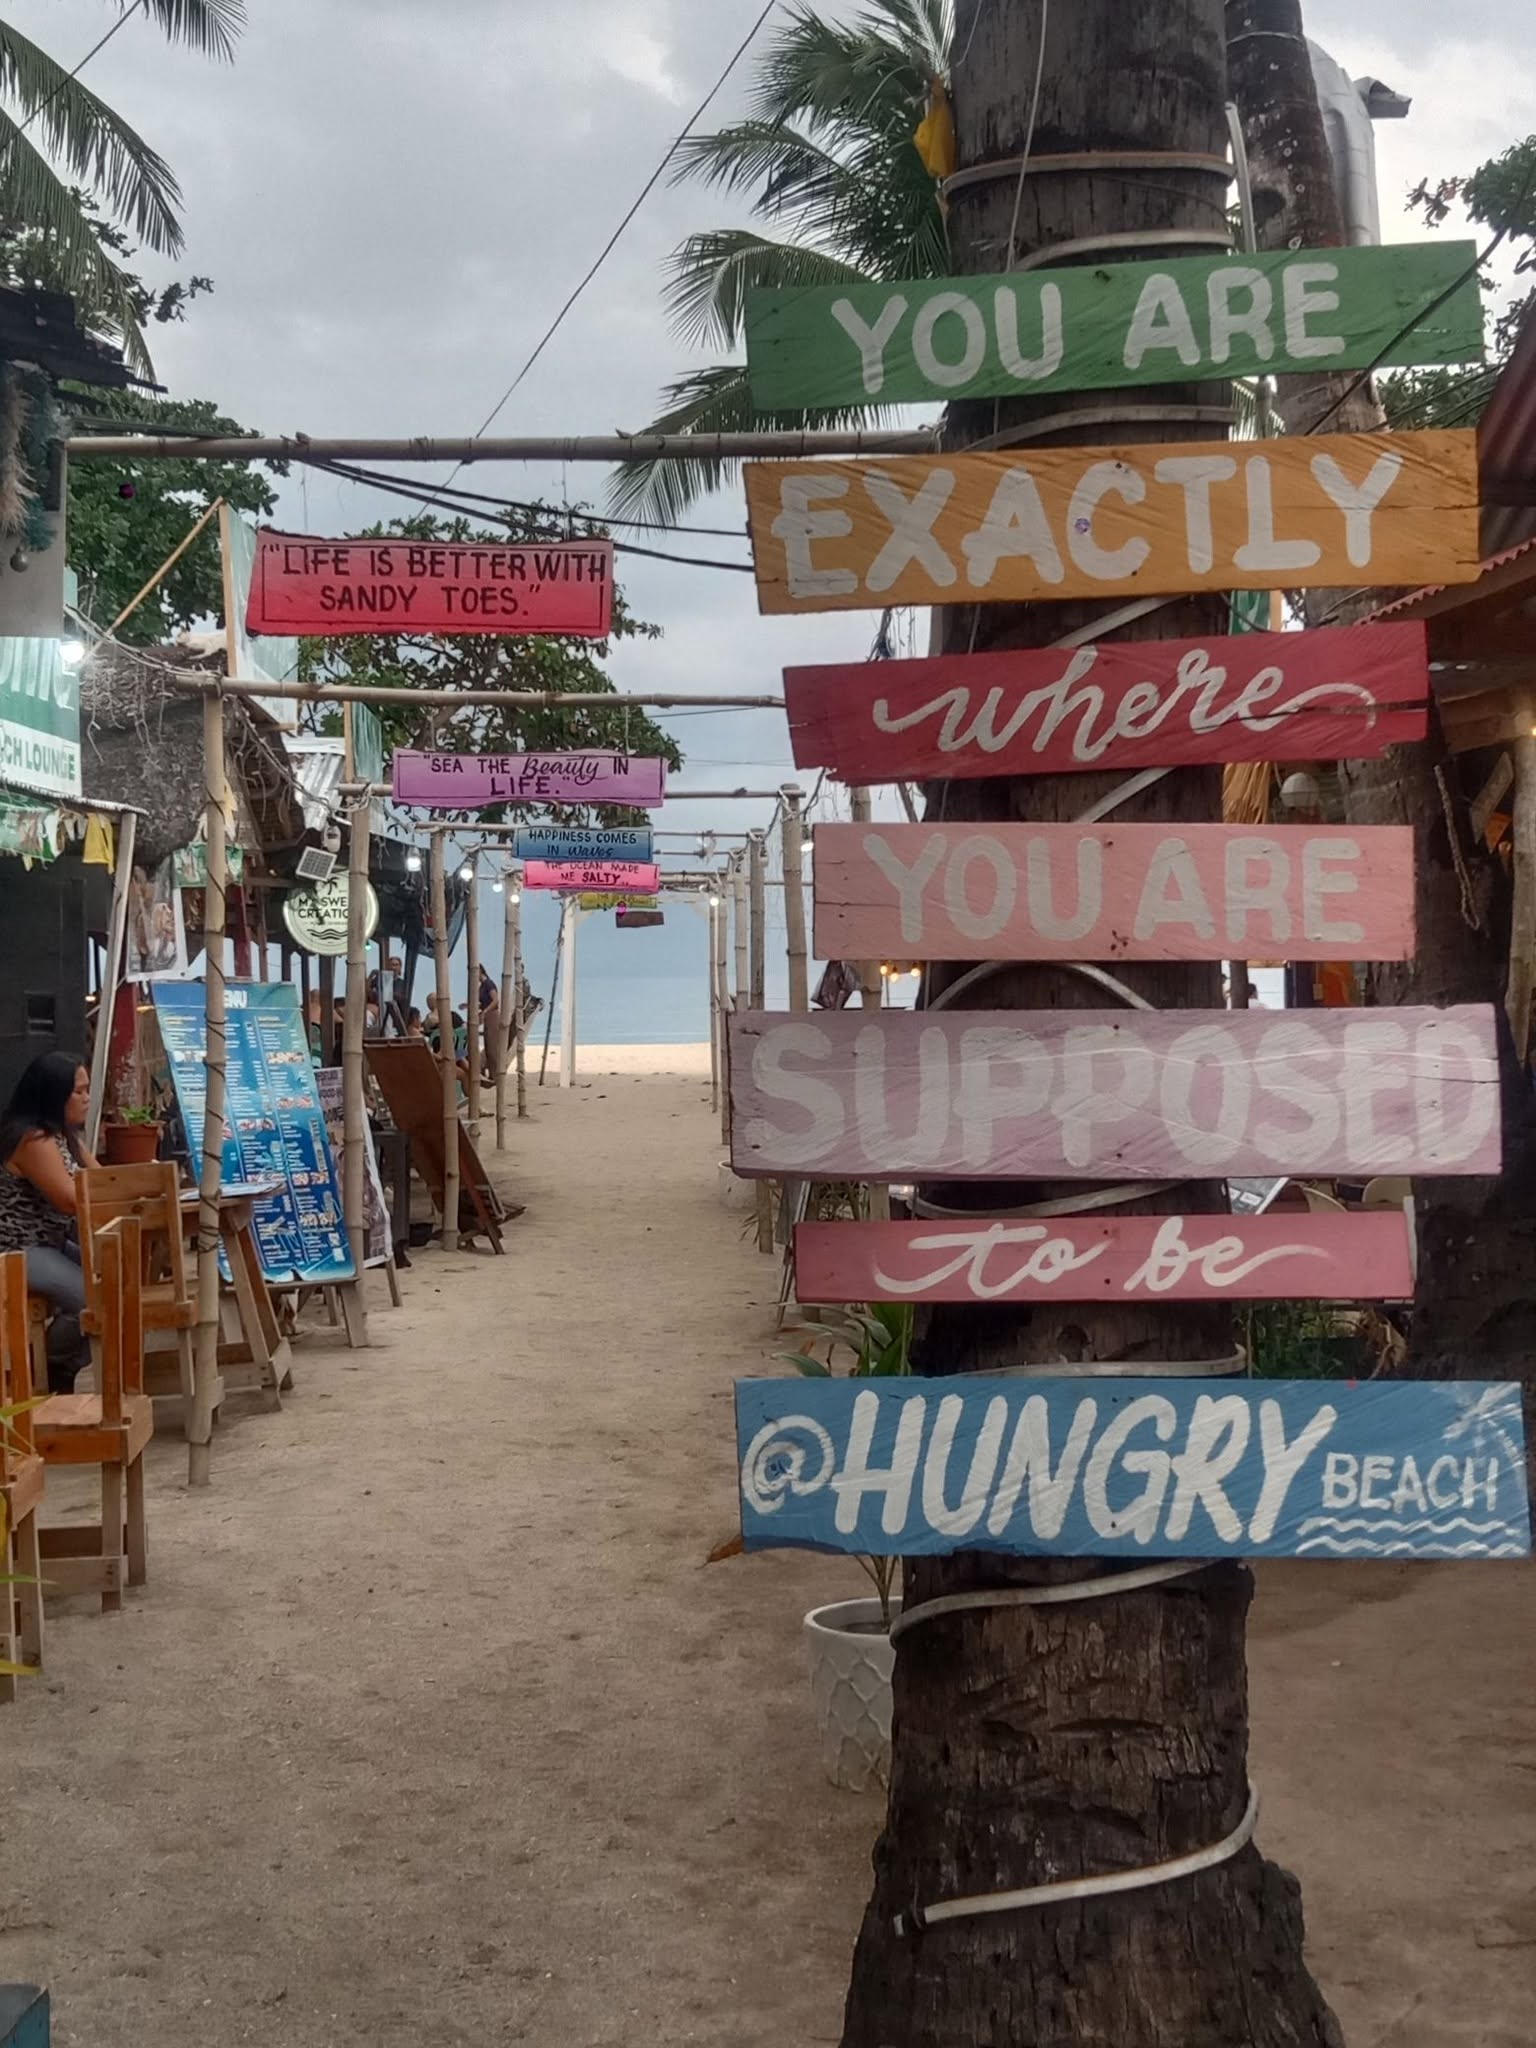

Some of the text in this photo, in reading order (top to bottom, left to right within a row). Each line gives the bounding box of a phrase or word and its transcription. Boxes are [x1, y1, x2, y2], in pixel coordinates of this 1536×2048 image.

[831, 261, 1345, 394] YOU ARE
[770, 452, 1402, 598] EXACTLY
[370, 549, 394, 577] IS
[407, 546, 527, 581] BETTER
[533, 552, 607, 583] WITH
[319, 584, 418, 613] SANDY
[873, 646, 1376, 763] where
[0, 734, 76, 781] CH LOUNGE
[477, 758, 511, 774] THE
[522, 756, 608, 785] Beauty
[612, 757, 630, 775] IN
[528, 829, 637, 844] HAPPINESS COMES
[547, 845, 560, 855] IN
[545, 861, 640, 874] THE OCEAN MADE
[560, 873, 575, 882] ME
[321, 896, 348, 907] SWE
[862, 832, 1364, 943] YOU ARE
[223, 989, 248, 1009] ENU
[743, 1019, 1498, 1168] SUPPOSED
[874, 1216, 1332, 1298] to be
[744, 1389, 1499, 1545] @HUNGRY BEACH
